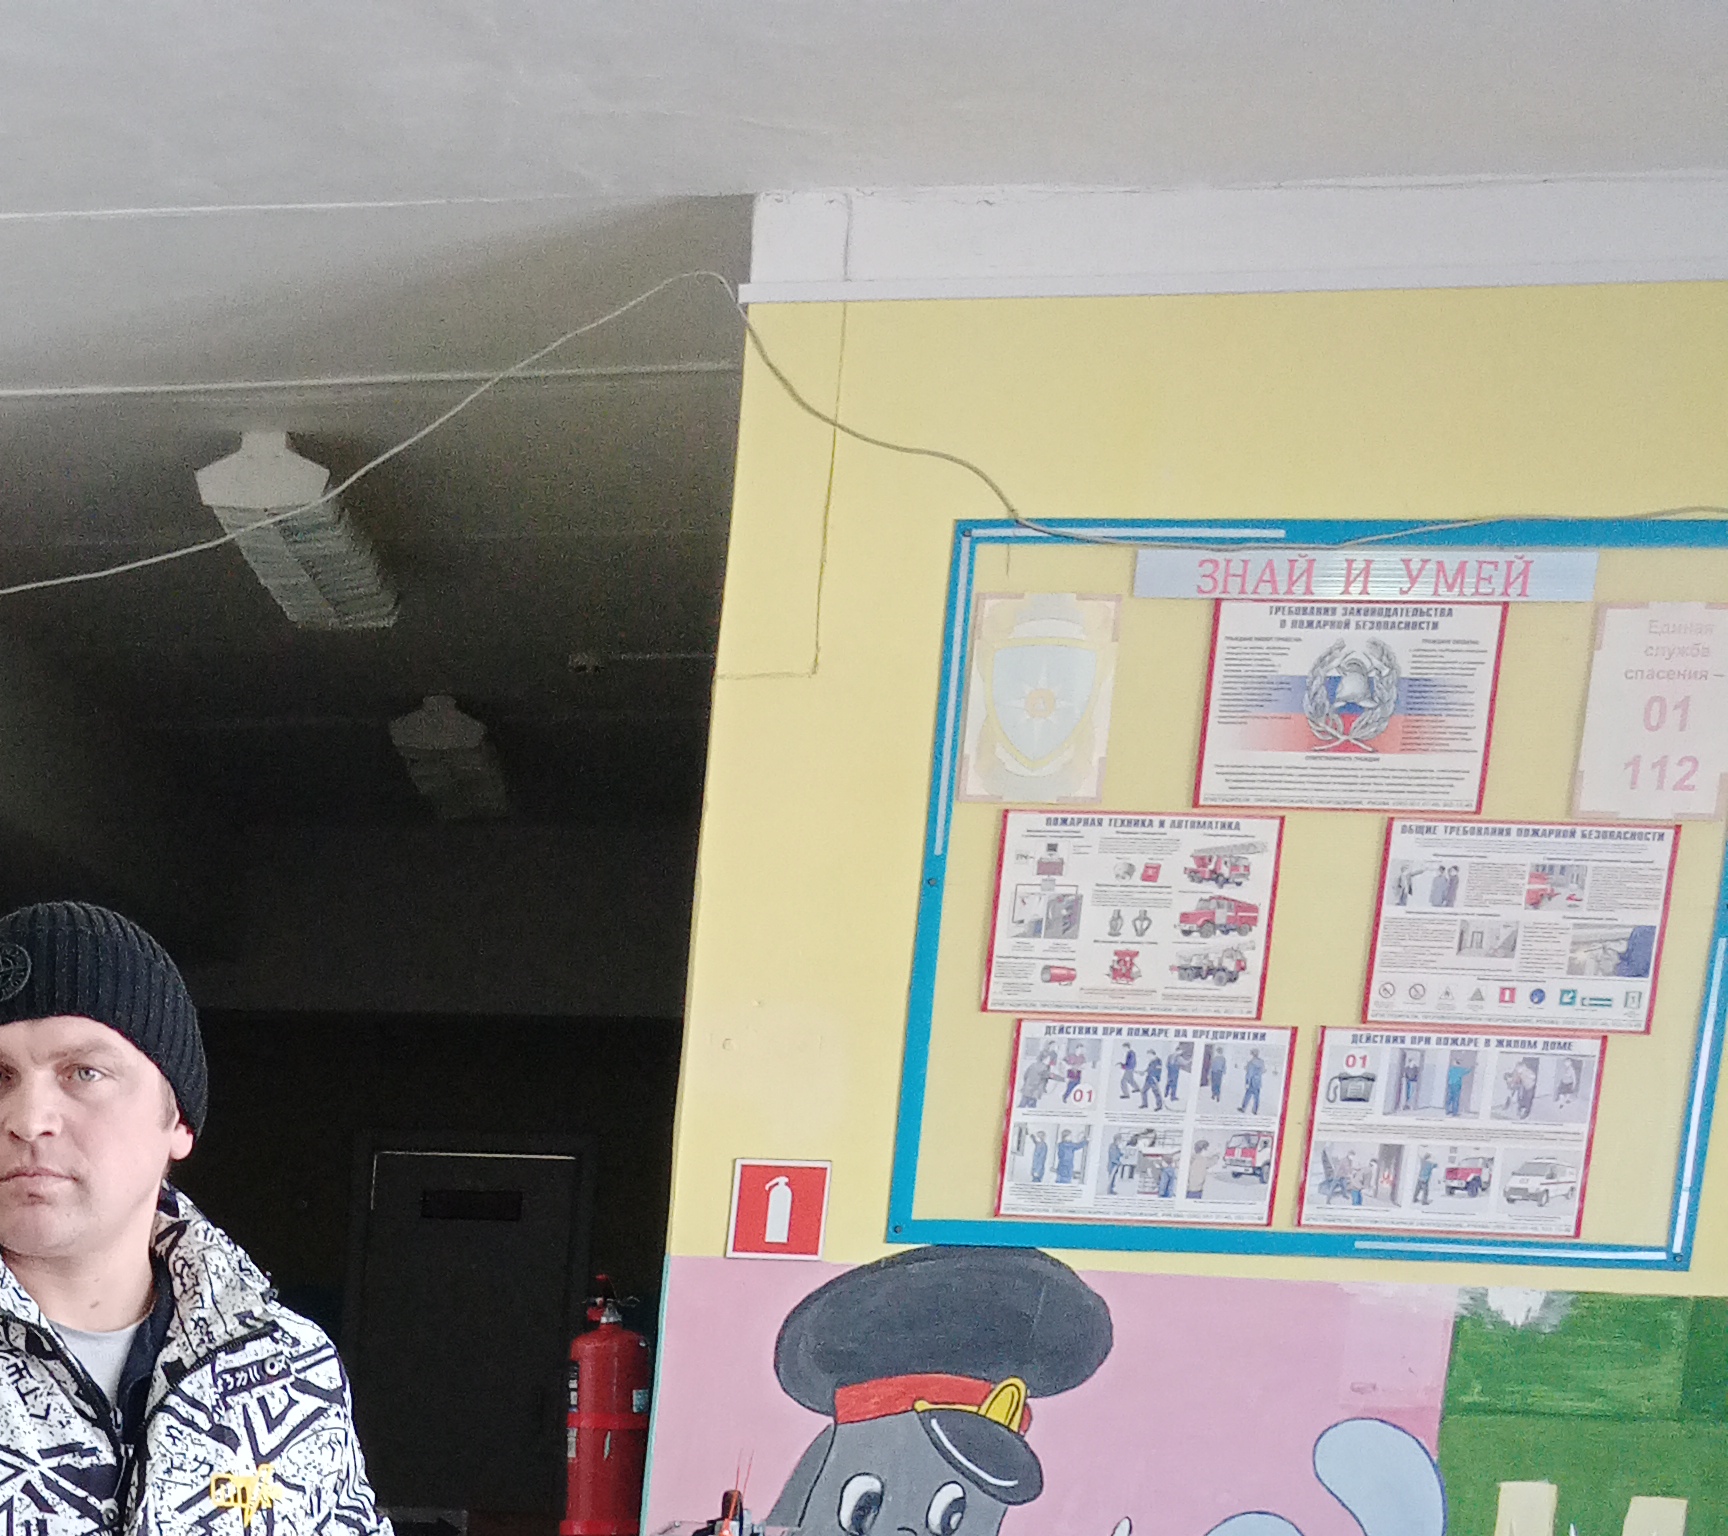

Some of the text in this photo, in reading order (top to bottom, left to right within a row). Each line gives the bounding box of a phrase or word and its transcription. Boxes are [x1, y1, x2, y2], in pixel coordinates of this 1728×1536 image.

[1196, 552, 1534, 598] ЗНАЙ И УМЕЙ
[1269, 605, 1454, 619] ТРЕБОВАНИЯ ЗАКОНОДАТЕЛЬСТВА
[1290, 618, 1351, 630] ПОЖАРНОЙ
[1355, 620, 1440, 631] БЕЗОПАСНОСТИ
[1648, 619, 1715, 636] Единая
[1644, 643, 1710, 660] служба
[1624, 667, 1709, 681] спасения
[1642, 694, 1691, 732] 01
[1624, 754, 1700, 792] 112
[1045, 816, 1241, 831] ПОЖАРНАЯ ТЕХНИКА И АВТОМАТИКА
[1400, 824, 1665, 842] ОБЩИЕ ТРЕБОВАНИЯ ПОЖАРНОЙ БЕЗОПАСНОСТИ
[1044, 1025, 1098, 1037] ДЕЙСТВИЯ
[1102, 1026, 1123, 1036] ПРИ
[1127, 1027, 1170, 1038] ПОЖАРЕ
[1192, 1029, 1267, 1042] ПРЕДПРИЯТИИ
[1351, 1033, 1406, 1045] ДЕЙСТВИЯ
[1410, 1034, 1431, 1046] ПРИ
[1435, 1036, 1480, 1047] ПОЖАРЕ
[1495, 1038, 1538, 1049] ЖИЛОМ
[1541, 1040, 1574, 1051] ДОМЕ
[1345, 1053, 1368, 1069] 01
[1073, 1088, 1093, 1102] 01
